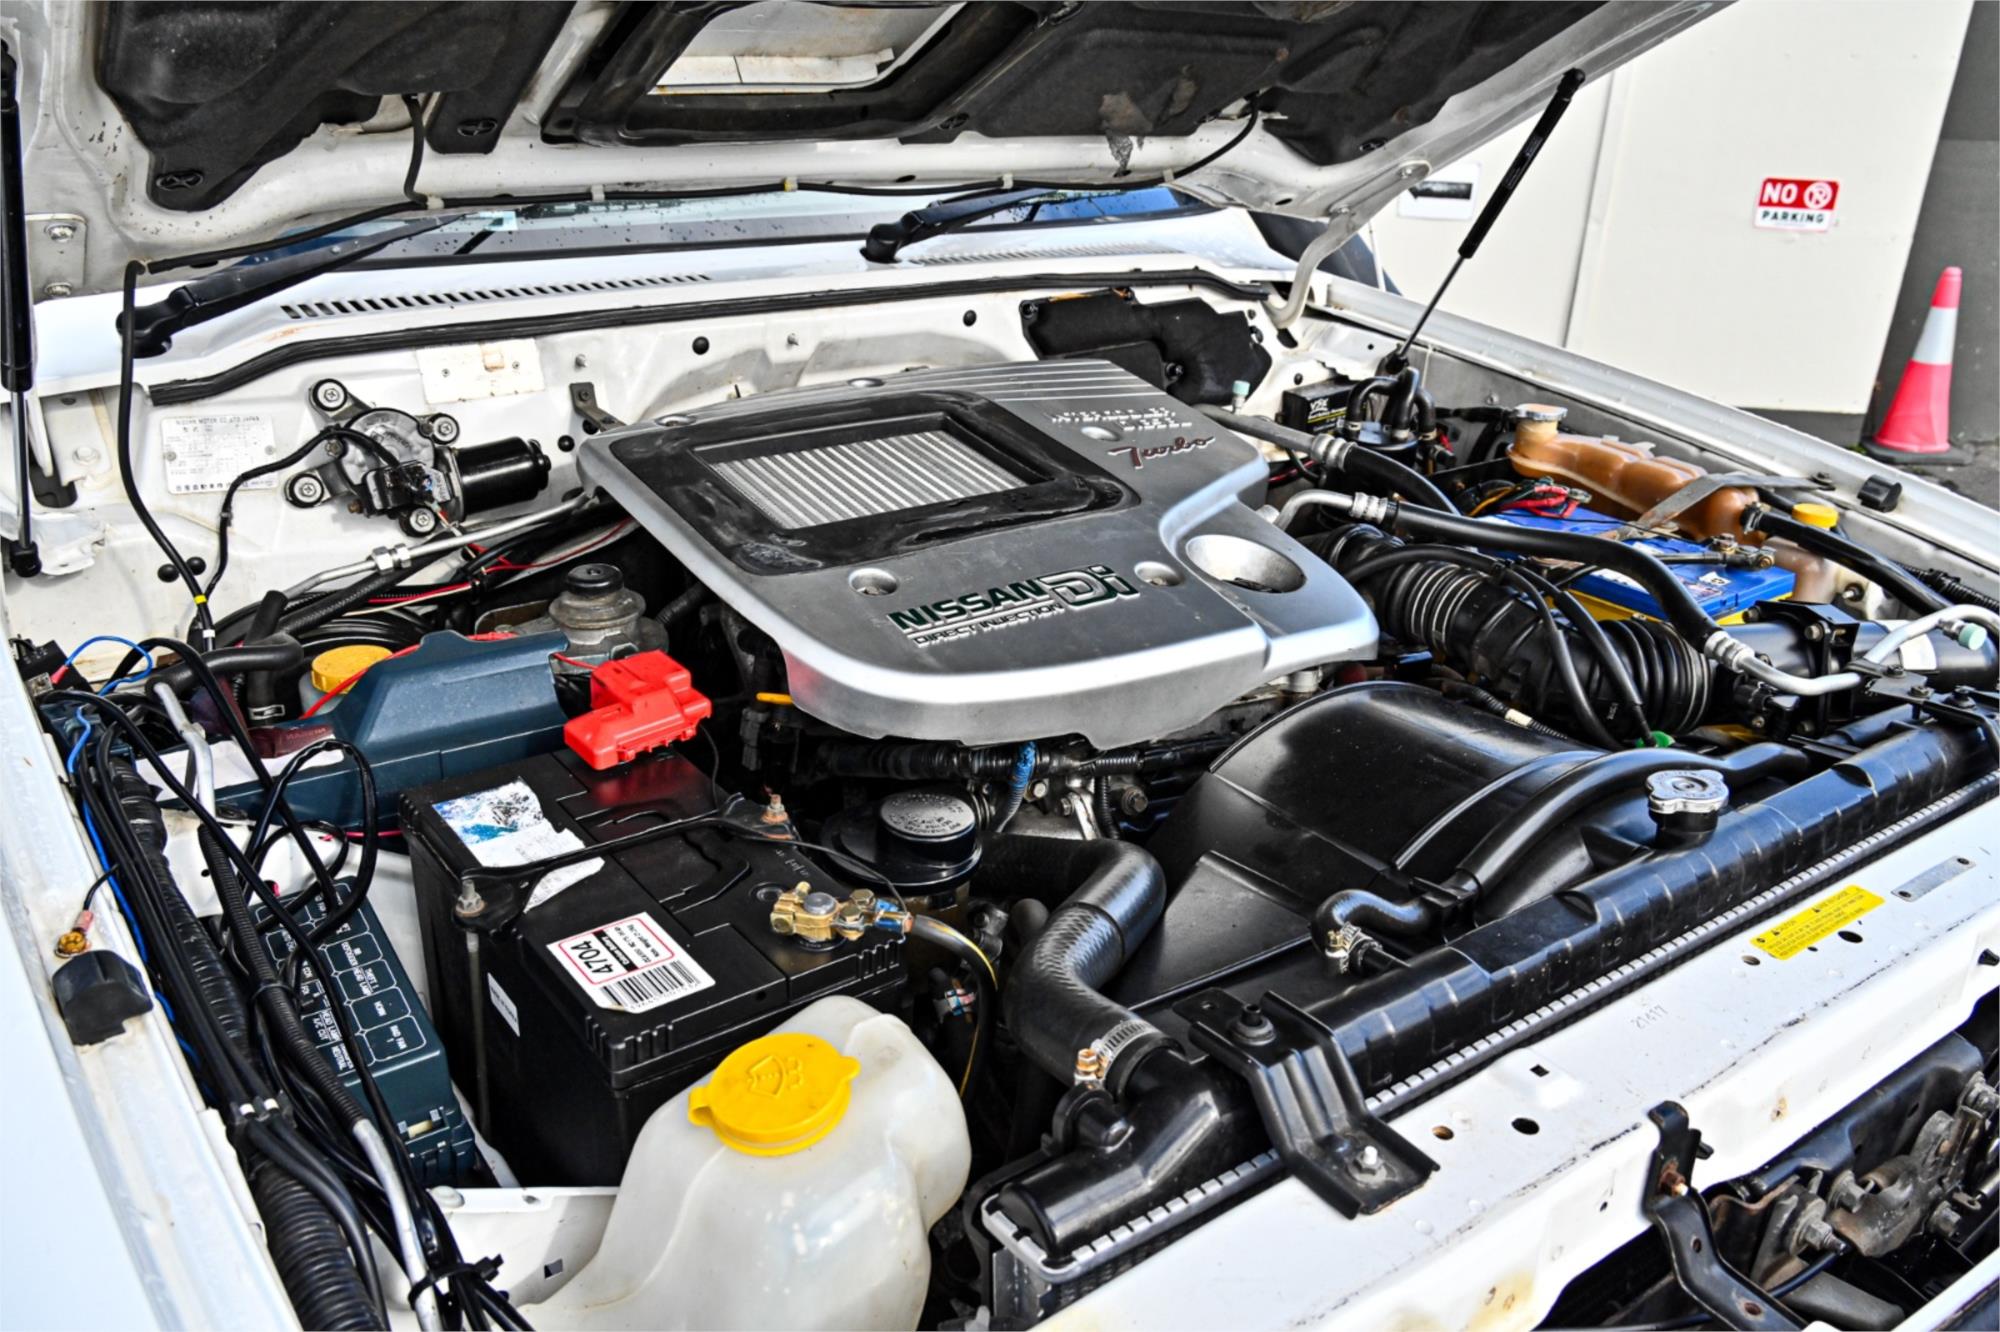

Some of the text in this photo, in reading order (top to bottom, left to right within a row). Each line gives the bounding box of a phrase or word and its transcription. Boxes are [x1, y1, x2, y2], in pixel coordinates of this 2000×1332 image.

[1761, 182, 1798, 204] NO
[1761, 210, 1825, 223] PARKING
[1107, 436, 1216, 470] Turbo
[888, 579, 1051, 633] NISSAN
[913, 601, 1066, 647] DIRECT INJECTION
[570, 940, 614, 974] 4704
